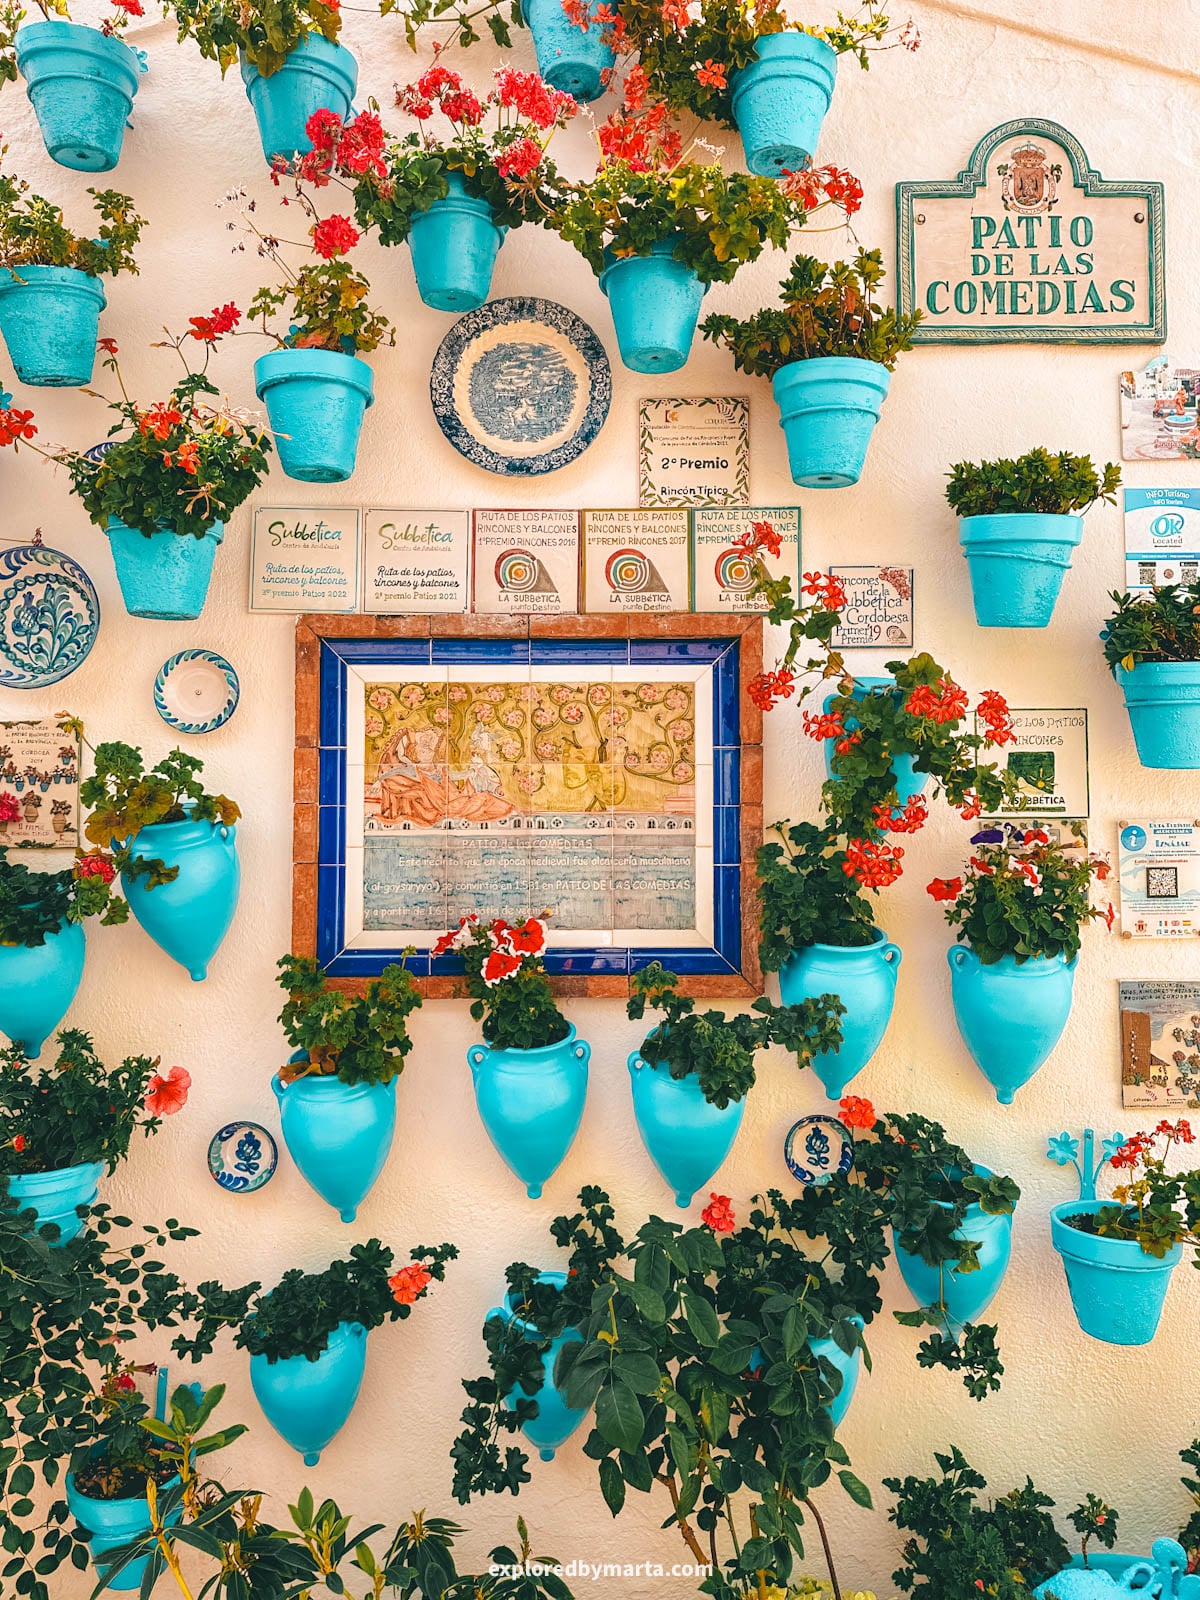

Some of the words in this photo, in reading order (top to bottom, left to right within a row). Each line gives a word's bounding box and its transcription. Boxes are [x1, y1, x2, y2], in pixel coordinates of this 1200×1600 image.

[971, 216, 1094, 249] PATIO
[971, 253, 1014, 276] DE
[1029, 252, 1094, 276] LAS
[926, 279, 1136, 316] COMEDIAS
[680, 456, 729, 470] Premio
[660, 486, 696, 496] Rincón
[697, 485, 729, 498] Típico
[481, 512, 505, 521] RUTA
[507, 512, 520, 521] DE
[522, 512, 540, 521] LOS
[541, 512, 574, 521] PATIOS
[592, 512, 615, 521] RUTA
[617, 512, 630, 521] DE
[633, 512, 649, 521] LOS
[652, 511, 684, 521] PATIOS
[701, 511, 725, 520] RUTA
[727, 511, 739, 520] DE
[741, 511, 759, 520] LOS
[761, 510, 794, 519] PATIOS
[477, 523, 522, 533] RINCONES
[523, 525, 530, 533] Y
[531, 525, 577, 534] BALCONES
[587, 523, 632, 534] RINCONES
[633, 525, 640, 534] Y
[641, 525, 687, 534] BALCONES
[697, 523, 741, 533] RINCONES
[743, 524, 749, 532] Y
[485, 536, 516, 546] PREMIO
[517, 537, 558, 547] RINCONES
[558, 538, 576, 546] 2016
[596, 536, 626, 546] PREMIO
[628, 535, 668, 546] RINCONES
[669, 536, 687, 545] 2017
[705, 534, 736, 544] PREMIO
[265, 562, 287, 575] Ruta
[289, 564, 300, 574] de
[301, 564, 314, 574] los
[314, 565, 344, 576] patios,
[377, 565, 399, 578] Ruta
[400, 567, 411, 576] de
[413, 567, 425, 576] los
[426, 567, 456, 578] patios,
[261, 574, 300, 584] rincones
[300, 577, 307, 588] y
[309, 575, 348, 585] balcones
[373, 578, 412, 587] rincones
[412, 580, 419, 590] y
[420, 578, 460, 588] balcones
[836, 575, 880, 586] incones
[272, 590, 300, 599] premio
[302, 588, 325, 598] Patios
[327, 590, 348, 598] 2022
[866, 586, 879, 596] de
[881, 584, 890, 596] la
[384, 593, 412, 602] premio
[413, 591, 437, 600] Patios
[439, 592, 458, 600] 2021
[498, 594, 510, 602] LA
[609, 594, 621, 603] LA
[718, 594, 731, 602] LA
[510, 603, 532, 611] punto
[532, 603, 560, 612] Destino
[623, 603, 643, 611] punto
[643, 603, 671, 611] Destino
[846, 607, 909, 625] Cordobesa
[841, 635, 874, 645] Premio
[1025, 717, 1045, 728] LOS
[1047, 716, 1085, 729] PATIOS
[1014, 795, 1065, 805] SBBÉTICA
[462, 839, 498, 849] PATIO
[501, 839, 513, 849] de
[516, 839, 530, 849] las
[533, 838, 593, 849] COMEDIAS
[399, 856, 421, 867] Este
[464, 858, 481, 869] que
[485, 857, 496, 867] en
[530, 855, 570, 866] medieval
[573, 855, 588, 866] fue
[640, 855, 690, 866] musulmana
[456, 879, 498, 891] convirtió
[501, 882, 512, 891] en
[542, 882, 554, 890] en
[556, 879, 591, 891] PATIO
[593, 880, 606, 891] DE
[609, 879, 630, 891] LAS
[364, 908, 370, 918] y
[373, 908, 379, 916] a
[381, 906, 411, 918] partir
[414, 906, 425, 916] de
[461, 907, 473, 916] en
[473, 906, 499, 917] patio
[502, 906, 513, 916] de
